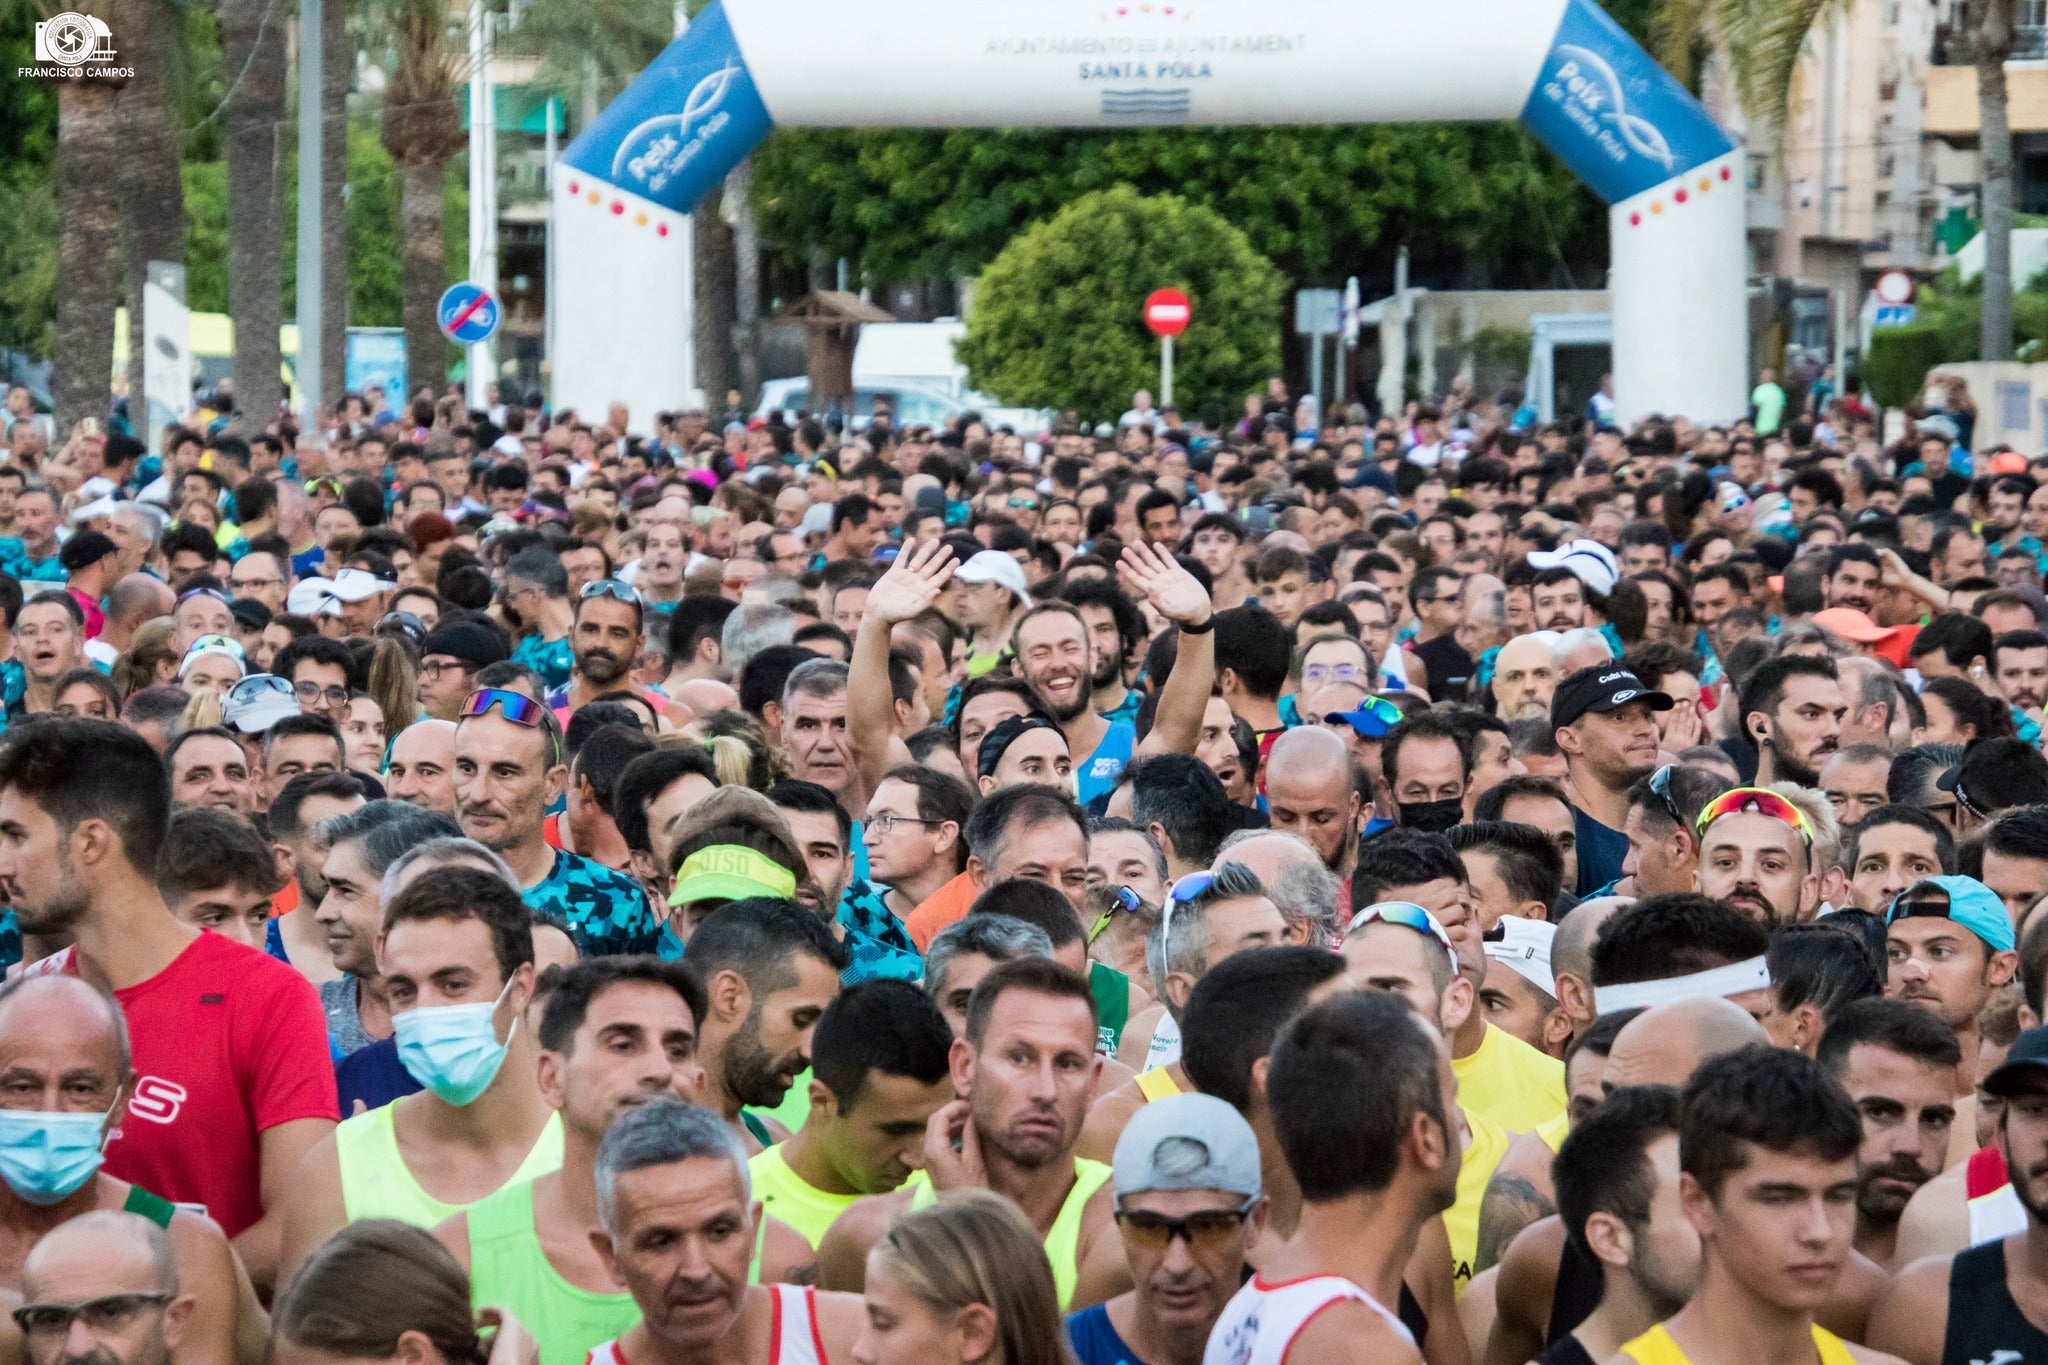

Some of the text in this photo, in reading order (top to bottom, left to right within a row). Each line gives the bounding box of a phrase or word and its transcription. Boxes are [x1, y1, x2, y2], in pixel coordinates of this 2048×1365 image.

[1079, 61, 1213, 79] SANTA POLA
[1555, 60, 1604, 111] Peix
[628, 132, 678, 181] Peix
